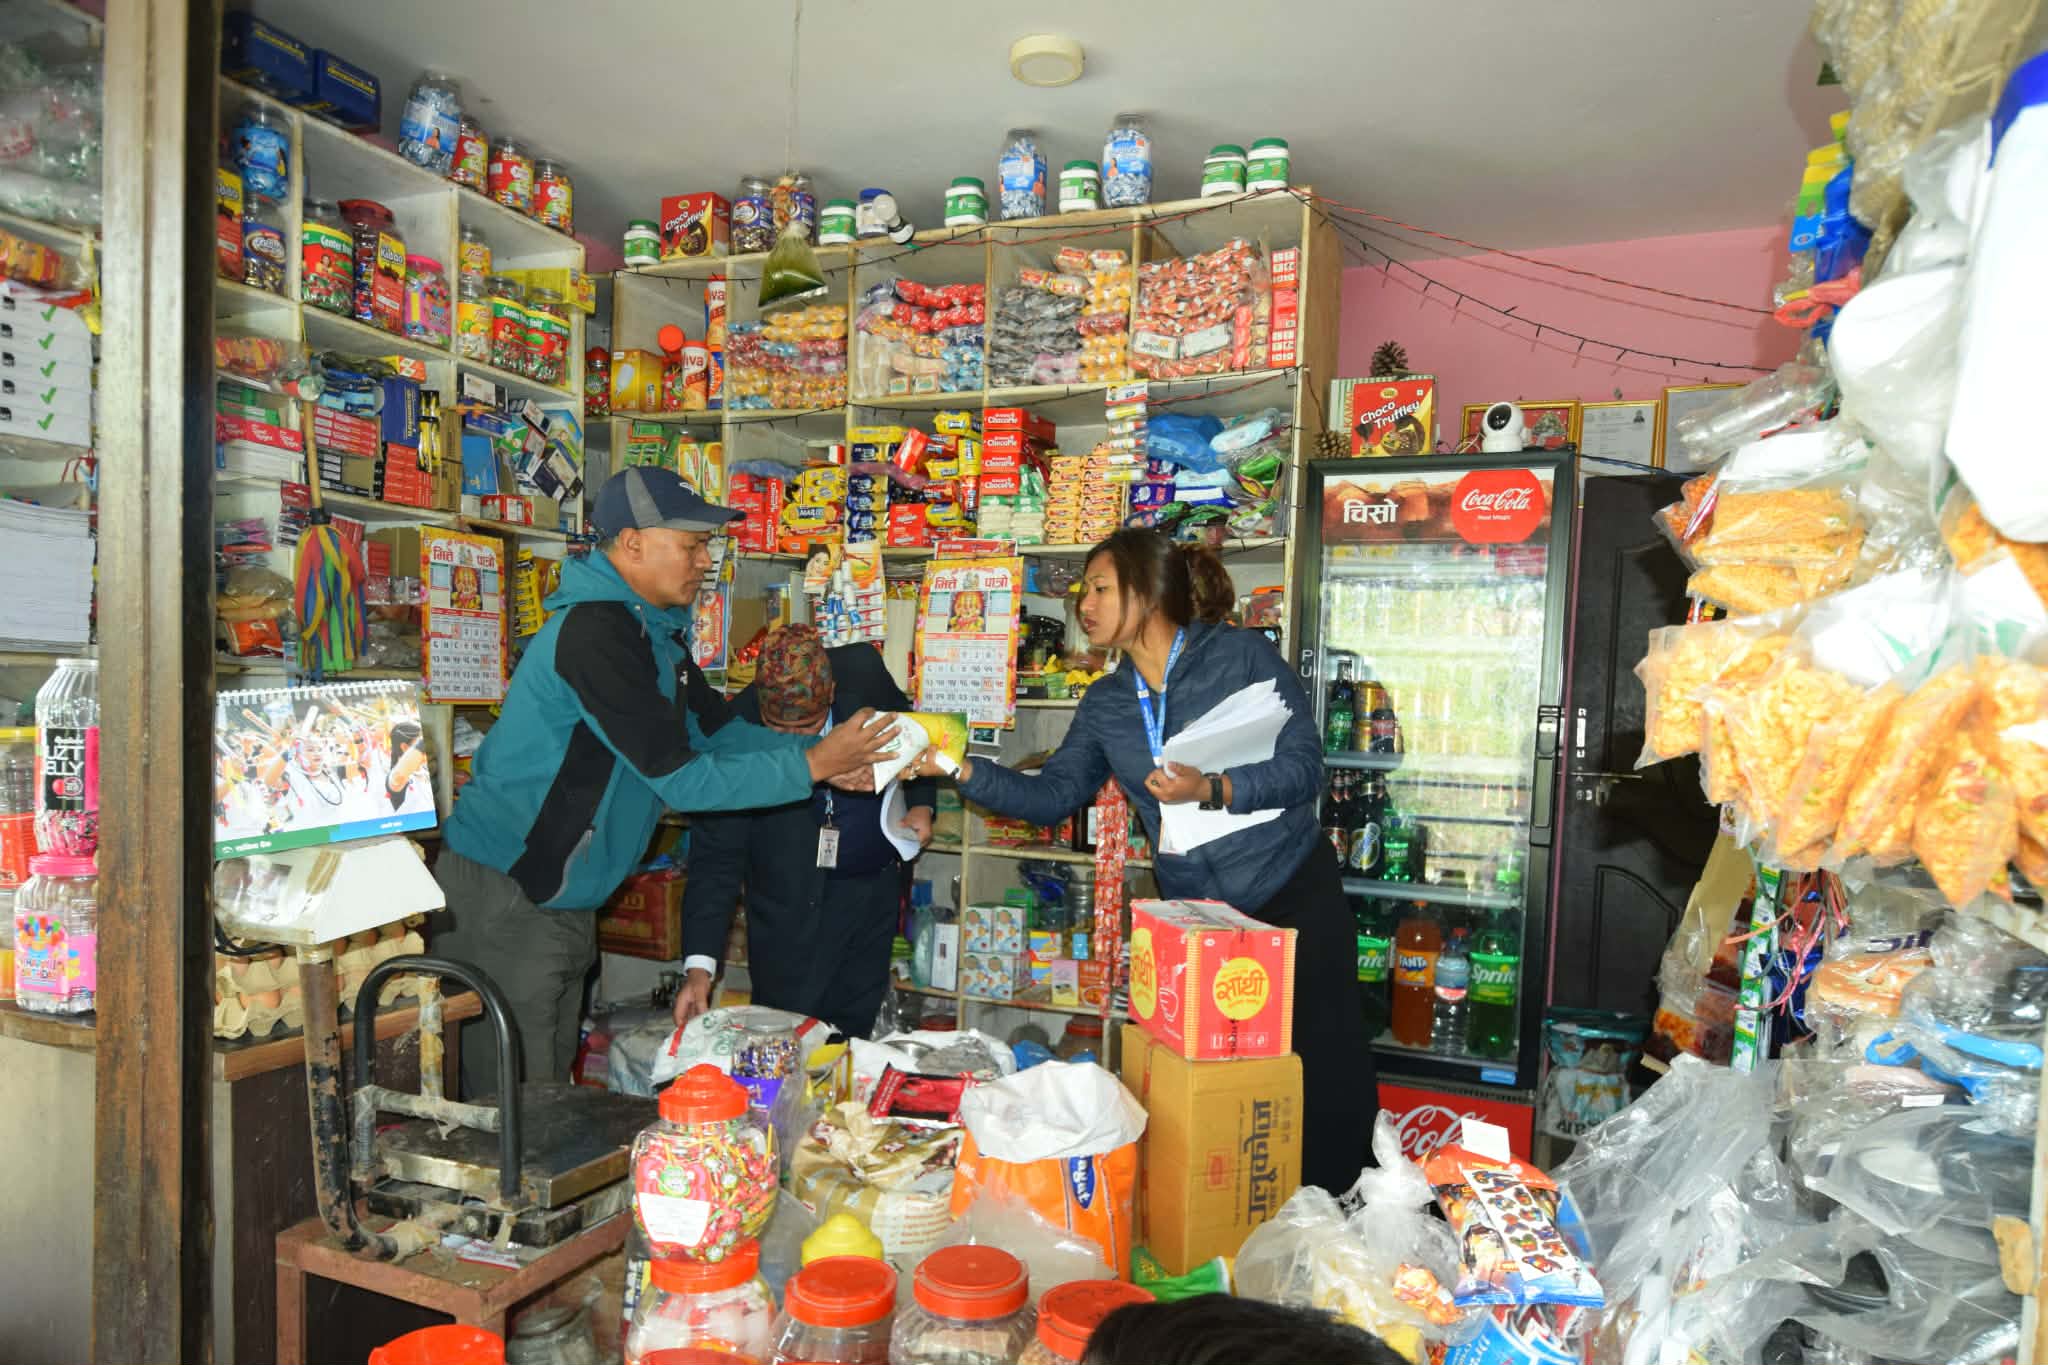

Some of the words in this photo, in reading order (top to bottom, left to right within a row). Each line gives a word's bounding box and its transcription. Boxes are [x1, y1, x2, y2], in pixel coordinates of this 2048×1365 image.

[665, 211, 688, 231] Choco
[1361, 402, 1395, 424] Choco
[1461, 488, 1534, 511] Coca-Cola
[1344, 498, 1399, 524] चिसो
[1216, 969, 1267, 1000] साथी
[1472, 964, 1515, 985] Sprite
